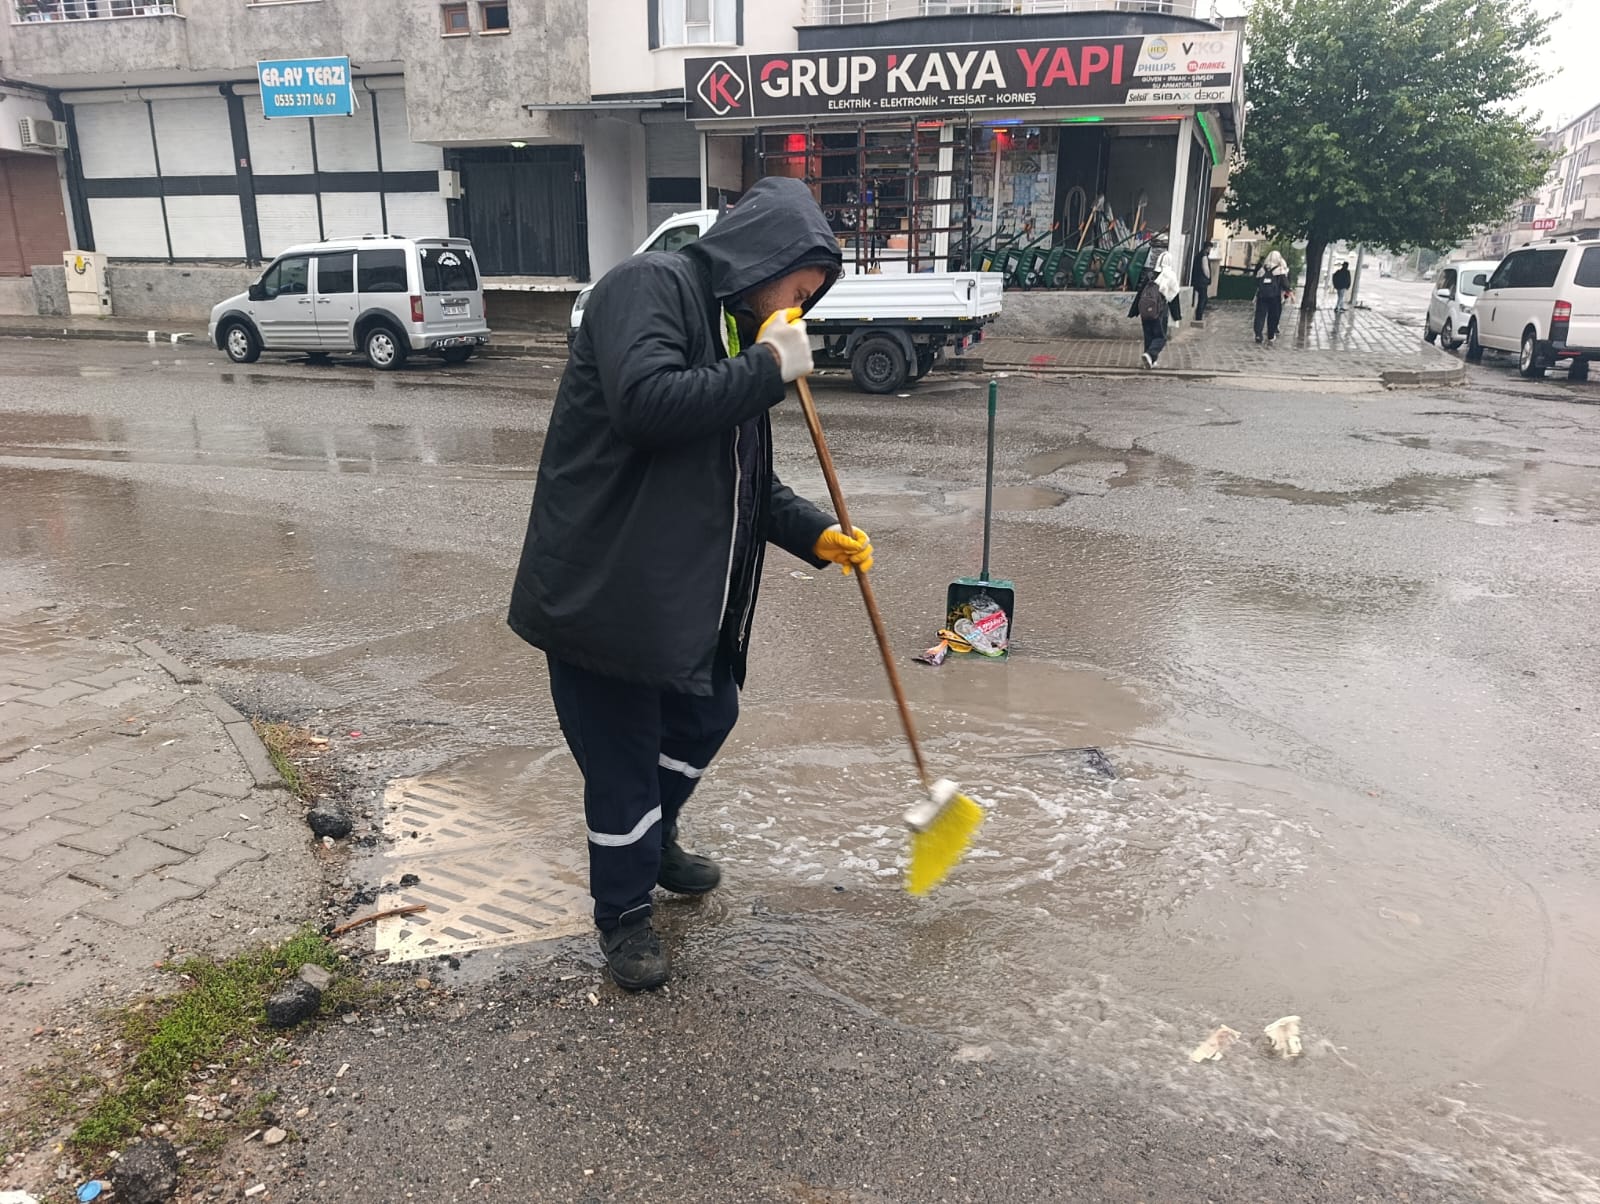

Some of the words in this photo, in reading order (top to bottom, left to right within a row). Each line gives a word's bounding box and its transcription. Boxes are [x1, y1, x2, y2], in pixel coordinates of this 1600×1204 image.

[261, 67, 303, 87] ER-AY
[760, 55, 877, 98] GRUP
[886, 50, 1007, 93] KAYA
[1016, 44, 1124, 88] YAPI
[1138, 63, 1176, 72] PHILIPS
[709, 72, 741, 107] K
[274, 94, 295, 107] 0535
[296, 93, 311, 106] 377
[313, 93, 324, 106] 06
[326, 92, 336, 105] 67
[828, 96, 871, 110] ELEKTRİK
[880, 95, 938, 108] ELEKTRONİK
[948, 93, 986, 105] TESİSAT
[996, 92, 1037, 105] KORNEŞ
